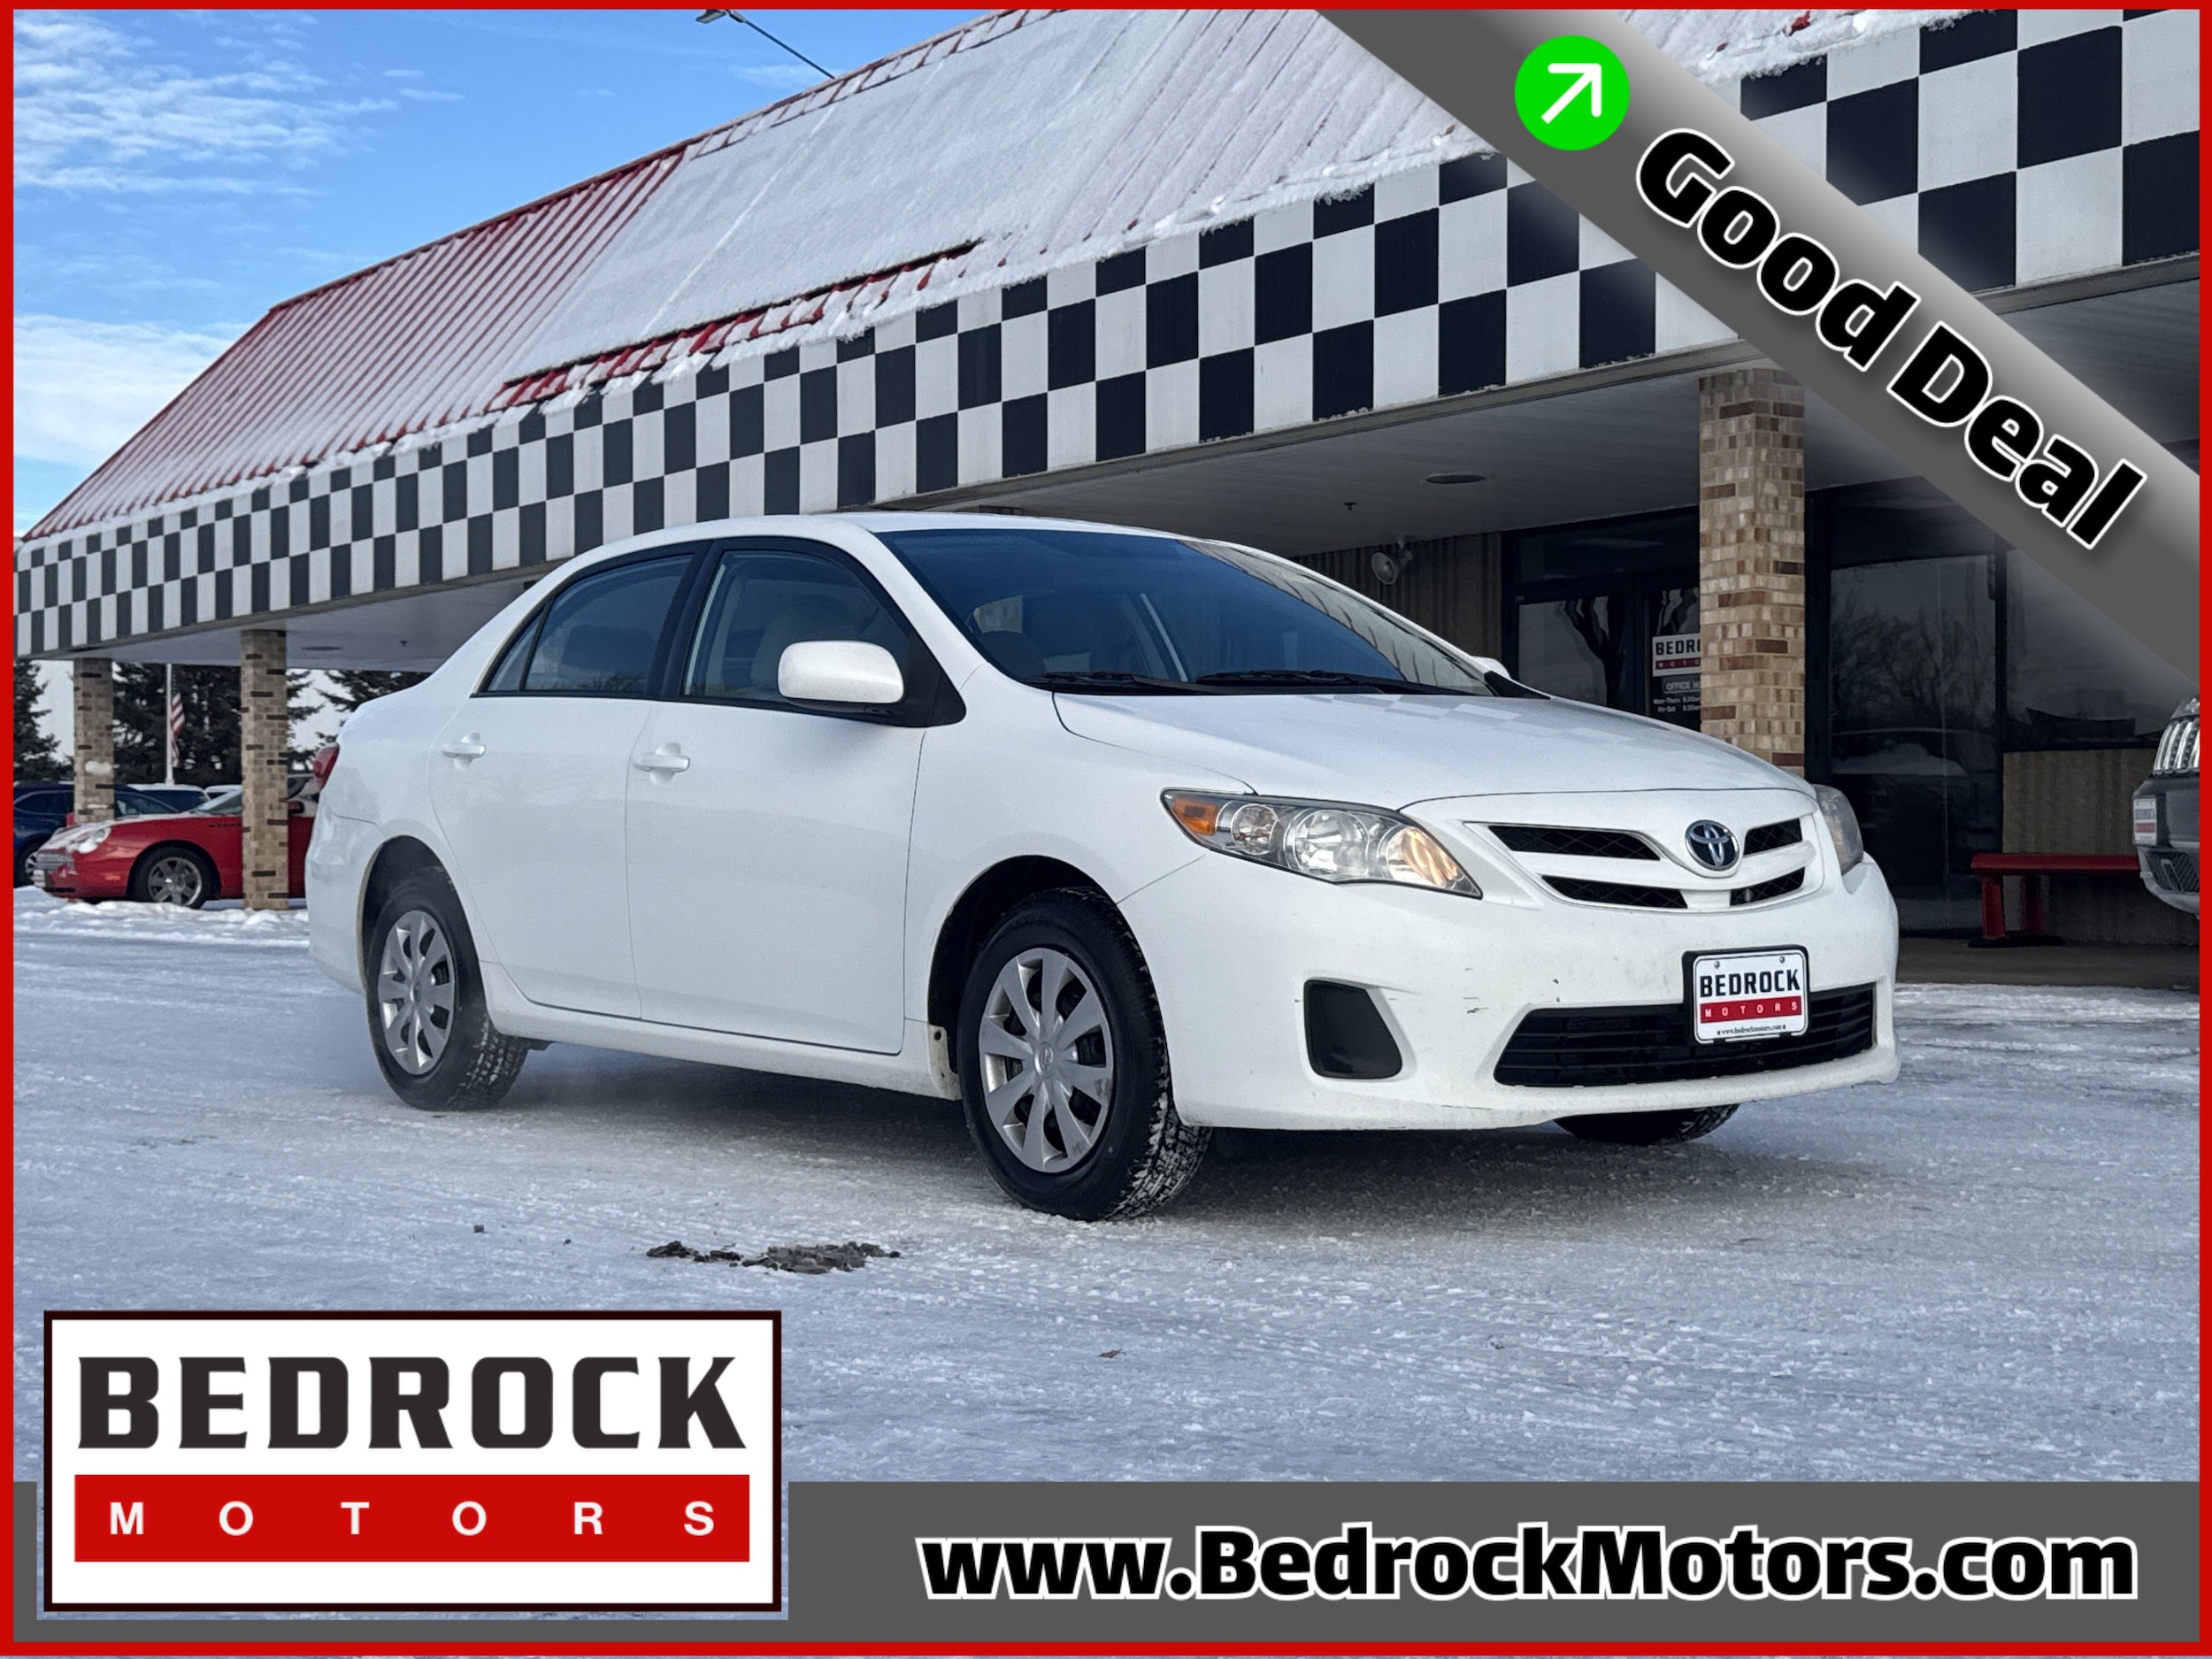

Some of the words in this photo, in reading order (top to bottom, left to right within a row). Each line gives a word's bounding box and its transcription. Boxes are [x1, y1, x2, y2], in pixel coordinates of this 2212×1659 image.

[1655, 639, 1700, 656] BEDR
[1700, 969, 1801, 998] BEDROCK
[1704, 1001, 1798, 1018] MOTORS
